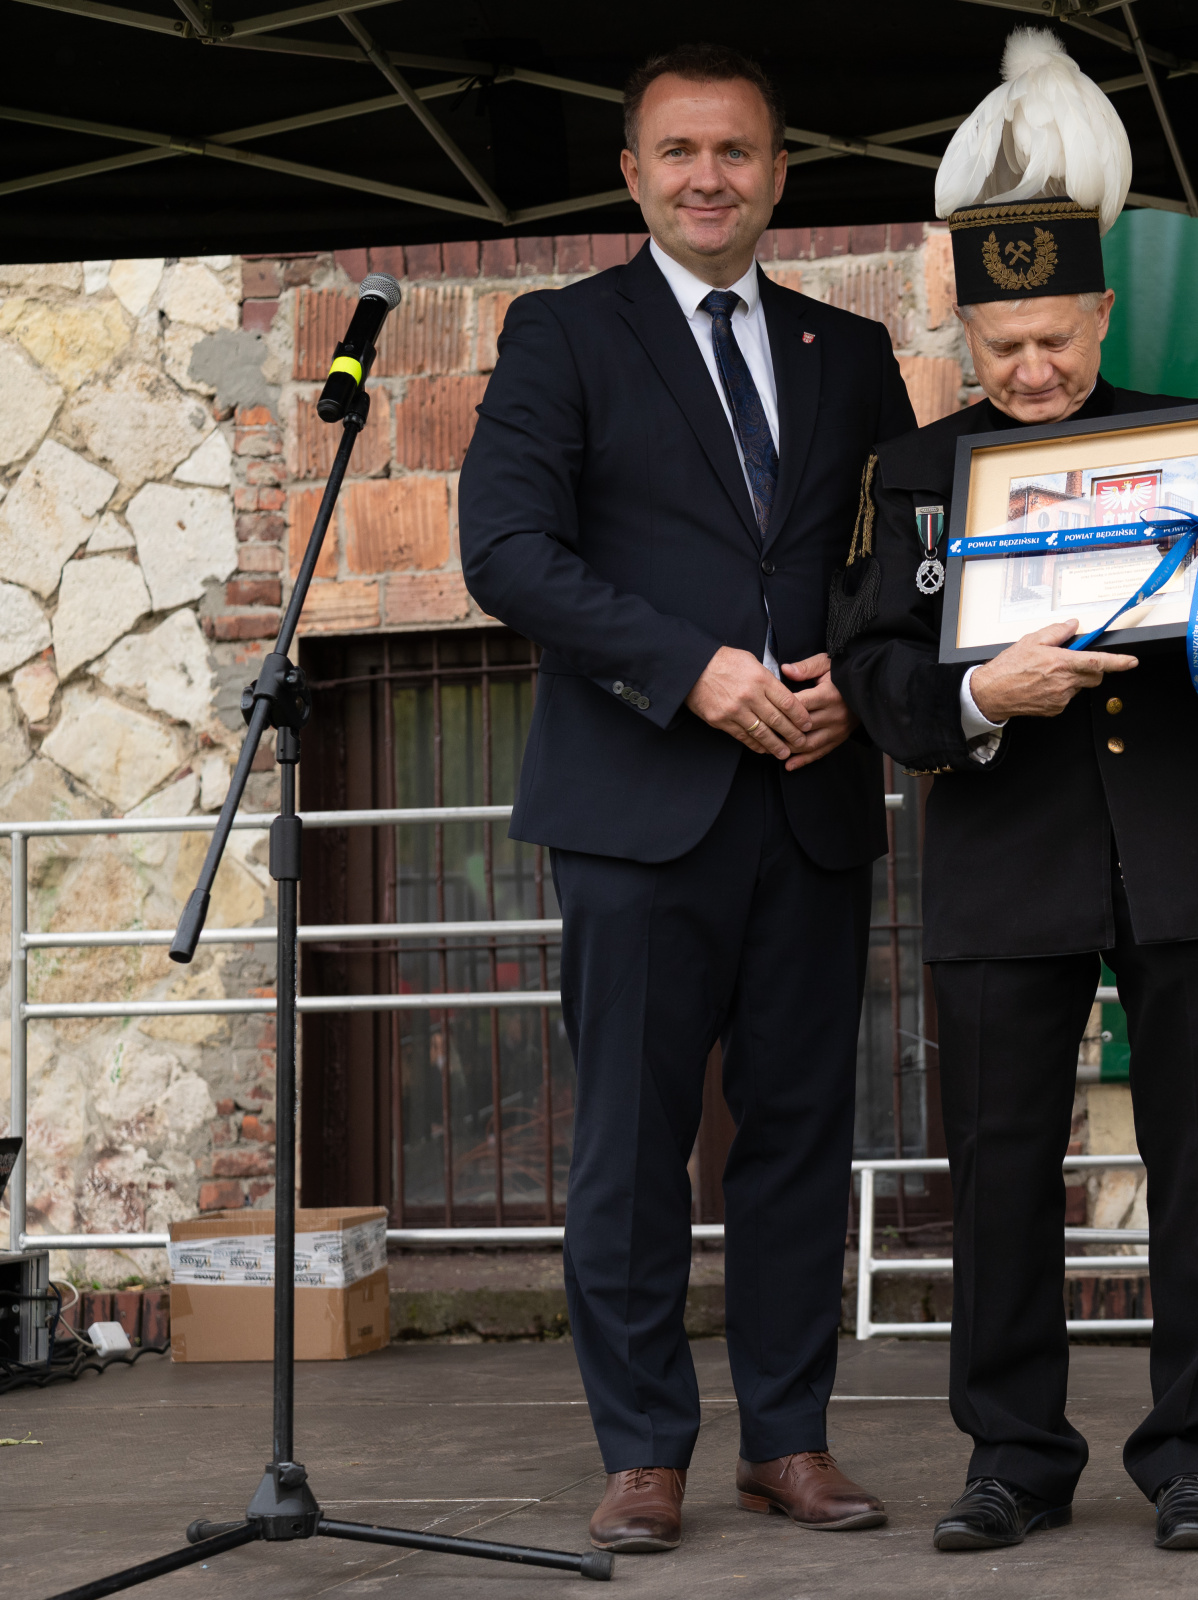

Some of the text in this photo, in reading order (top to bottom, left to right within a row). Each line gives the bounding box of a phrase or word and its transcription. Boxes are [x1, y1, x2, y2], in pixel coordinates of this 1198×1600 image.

[1064, 528, 1137, 542] POWIAT BĘDZIŃSKI
[967, 537, 1040, 549] POWIAT BĘDZIŃSKI
